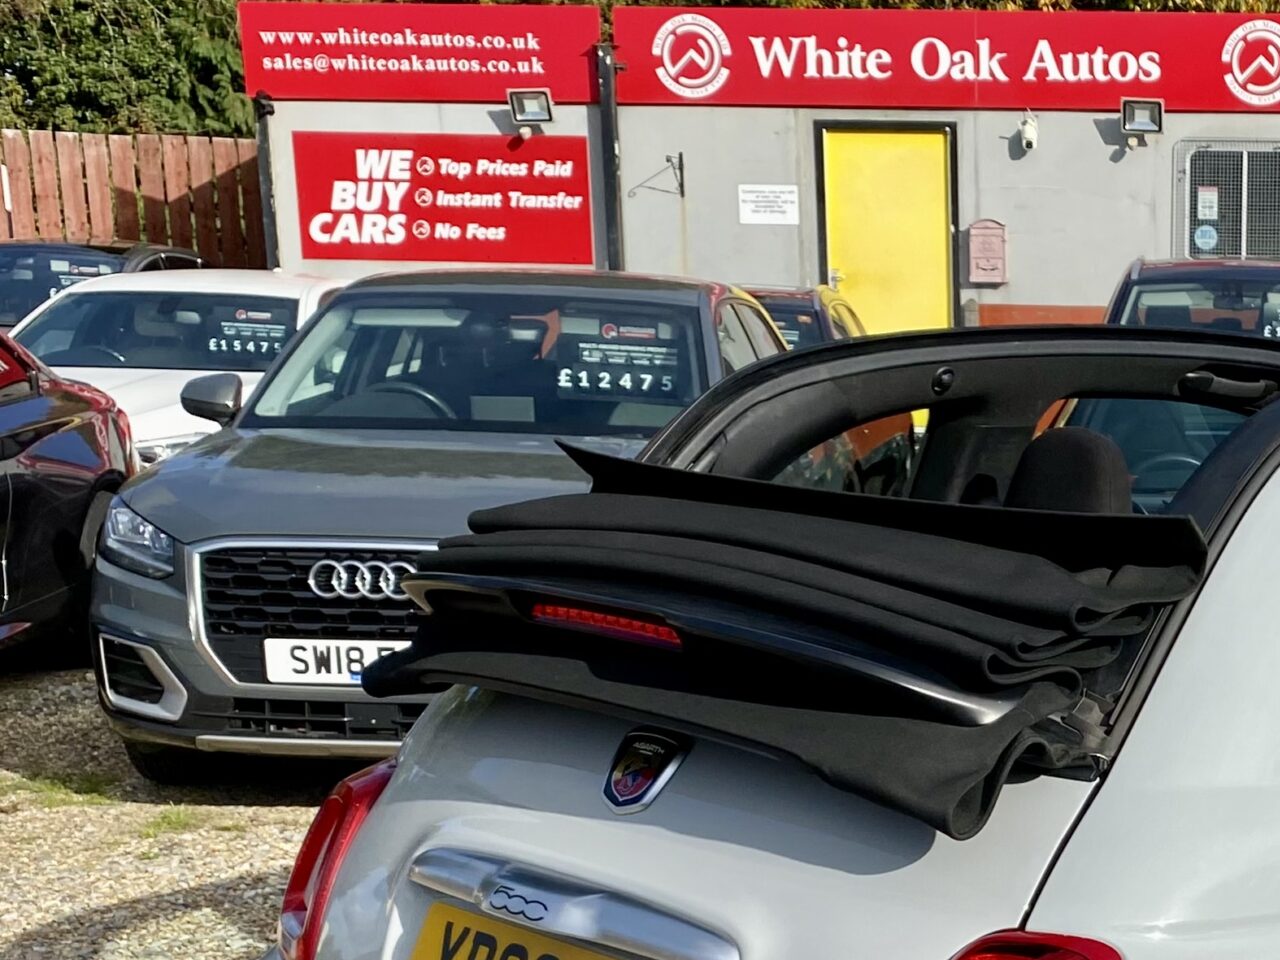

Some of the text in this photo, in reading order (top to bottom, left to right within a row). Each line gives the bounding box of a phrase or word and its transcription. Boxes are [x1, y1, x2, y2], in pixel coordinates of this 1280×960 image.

[259, 28, 541, 50] www.whiteoakautos.co.uk
[262, 53, 546, 74] sales@whiteoakautos.co.uk
[748, 35, 1162, 83] White Oak Autos
[355, 148, 413, 180] WE
[437, 157, 574, 180] Top Prices Paid
[330, 180, 410, 212] BUY
[436, 189, 584, 209] Instant Transfer
[308, 212, 407, 245] CARS
[433, 222, 506, 241] No Fees
[208, 337, 282, 353] £15475
[557, 368, 673, 392] £12475
[289, 644, 366, 675] SW18
[488, 885, 549, 922] 500
